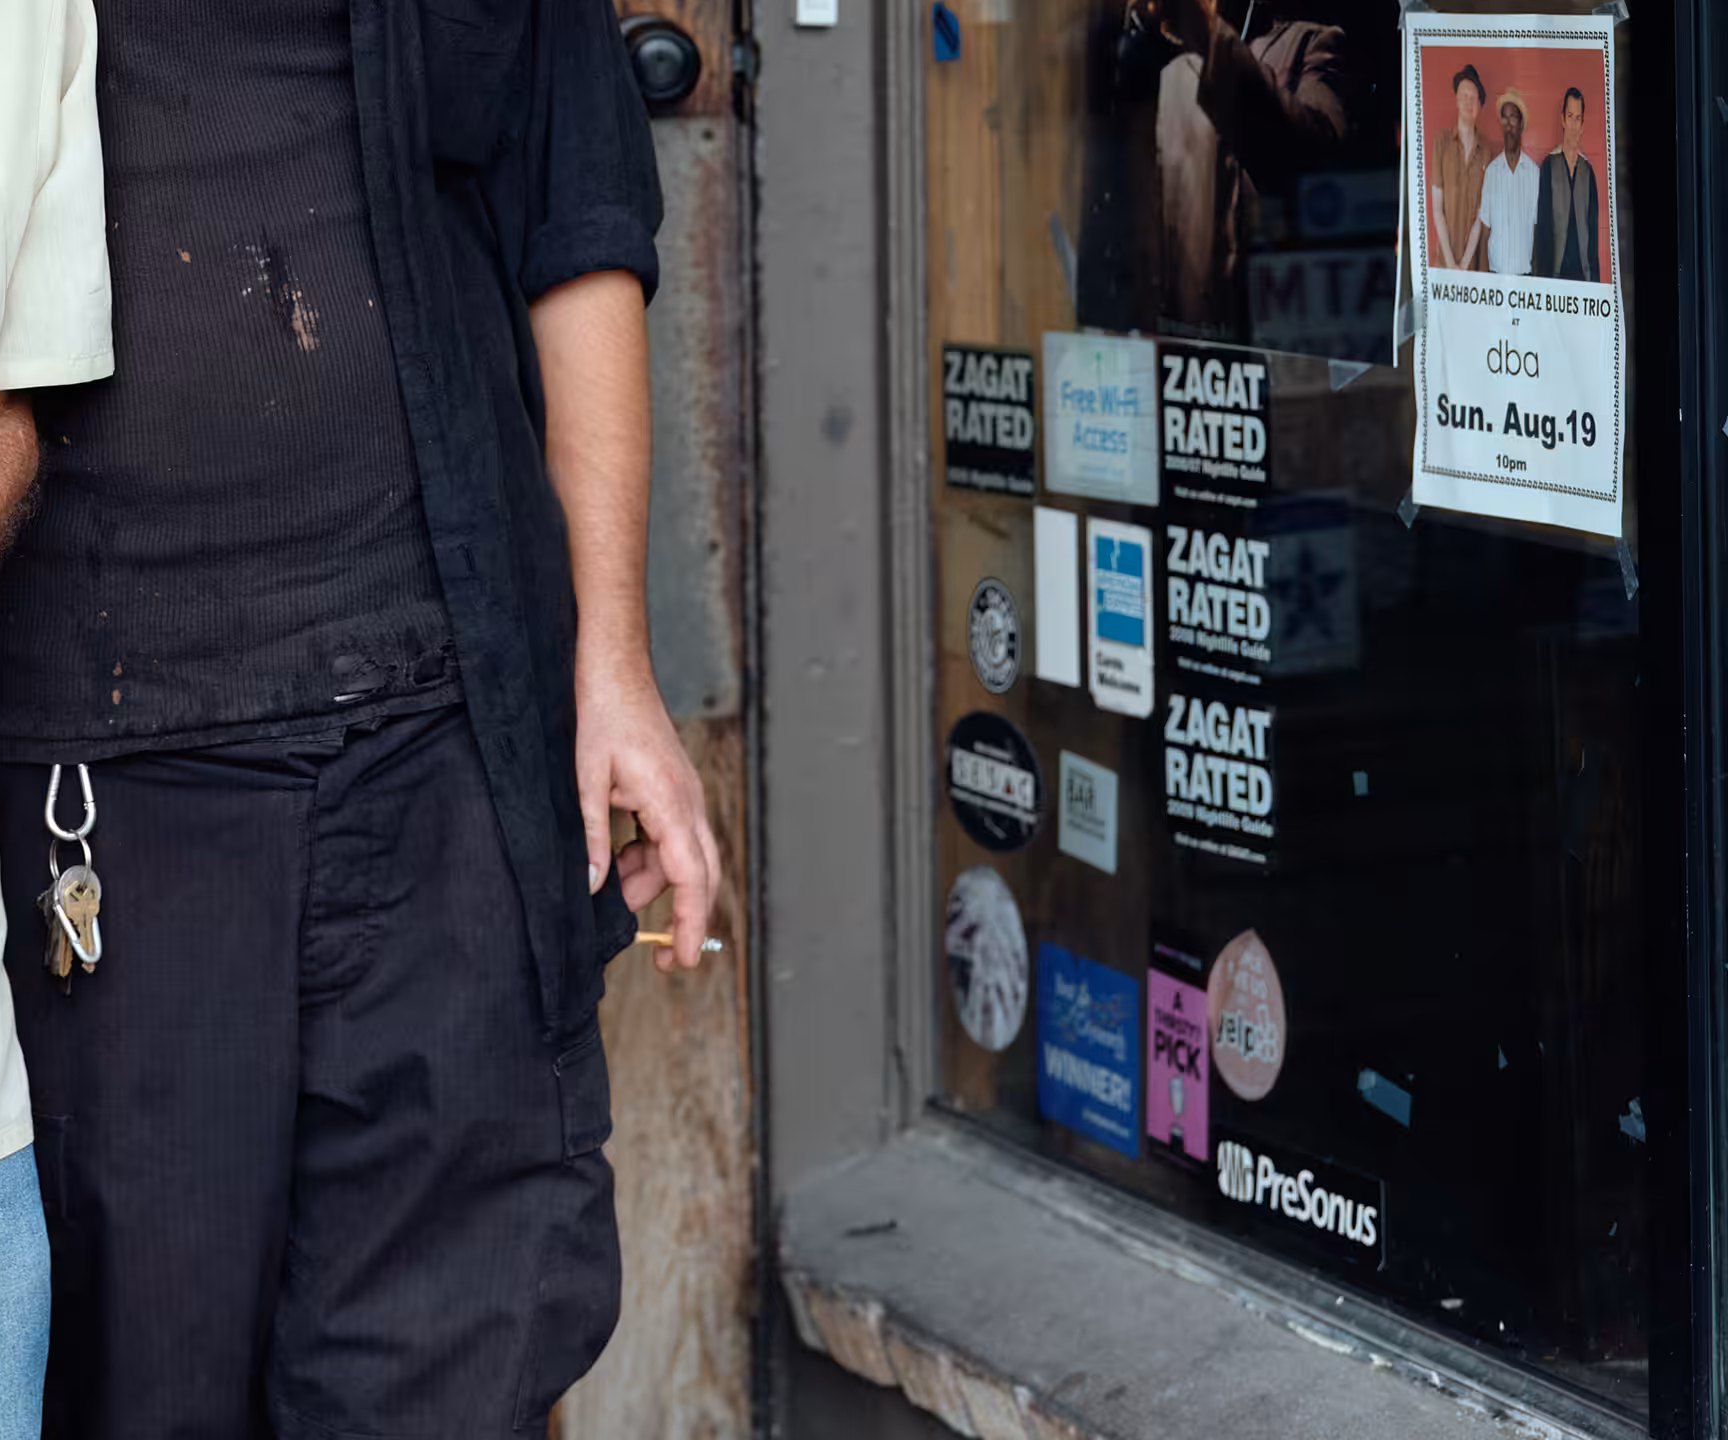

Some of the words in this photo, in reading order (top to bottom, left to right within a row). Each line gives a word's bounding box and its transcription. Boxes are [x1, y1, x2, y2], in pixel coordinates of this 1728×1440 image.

[1431, 282, 1504, 308] WASHBOARD
[1507, 290, 1542, 311] CHAZ
[1545, 294, 1580, 315] BLUES
[1582, 296, 1611, 318] TRIO
[1511, 318, 1520, 326] AT
[944, 350, 1034, 404] ZAGAT
[1162, 353, 1267, 411] ZAGAT
[1486, 339, 1540, 379] dba
[1061, 381, 1097, 409] Free
[1436, 393, 1493, 433] Sun.
[945, 397, 1035, 452] RATED
[1073, 422, 1129, 456] Access
[1162, 404, 1267, 465] RATED
[1495, 453, 1528, 473] 10pm
[1166, 523, 1271, 590] ZAGAT
[1167, 575, 1272, 643] RATED
[1165, 692, 1273, 763] ZAGAT
[1165, 745, 1273, 819] RATED
[1154, 1029, 1202, 1082] PICK
[1216, 1013, 1256, 1057] yelp
[1255, 1153, 1378, 1247] PreSonus
